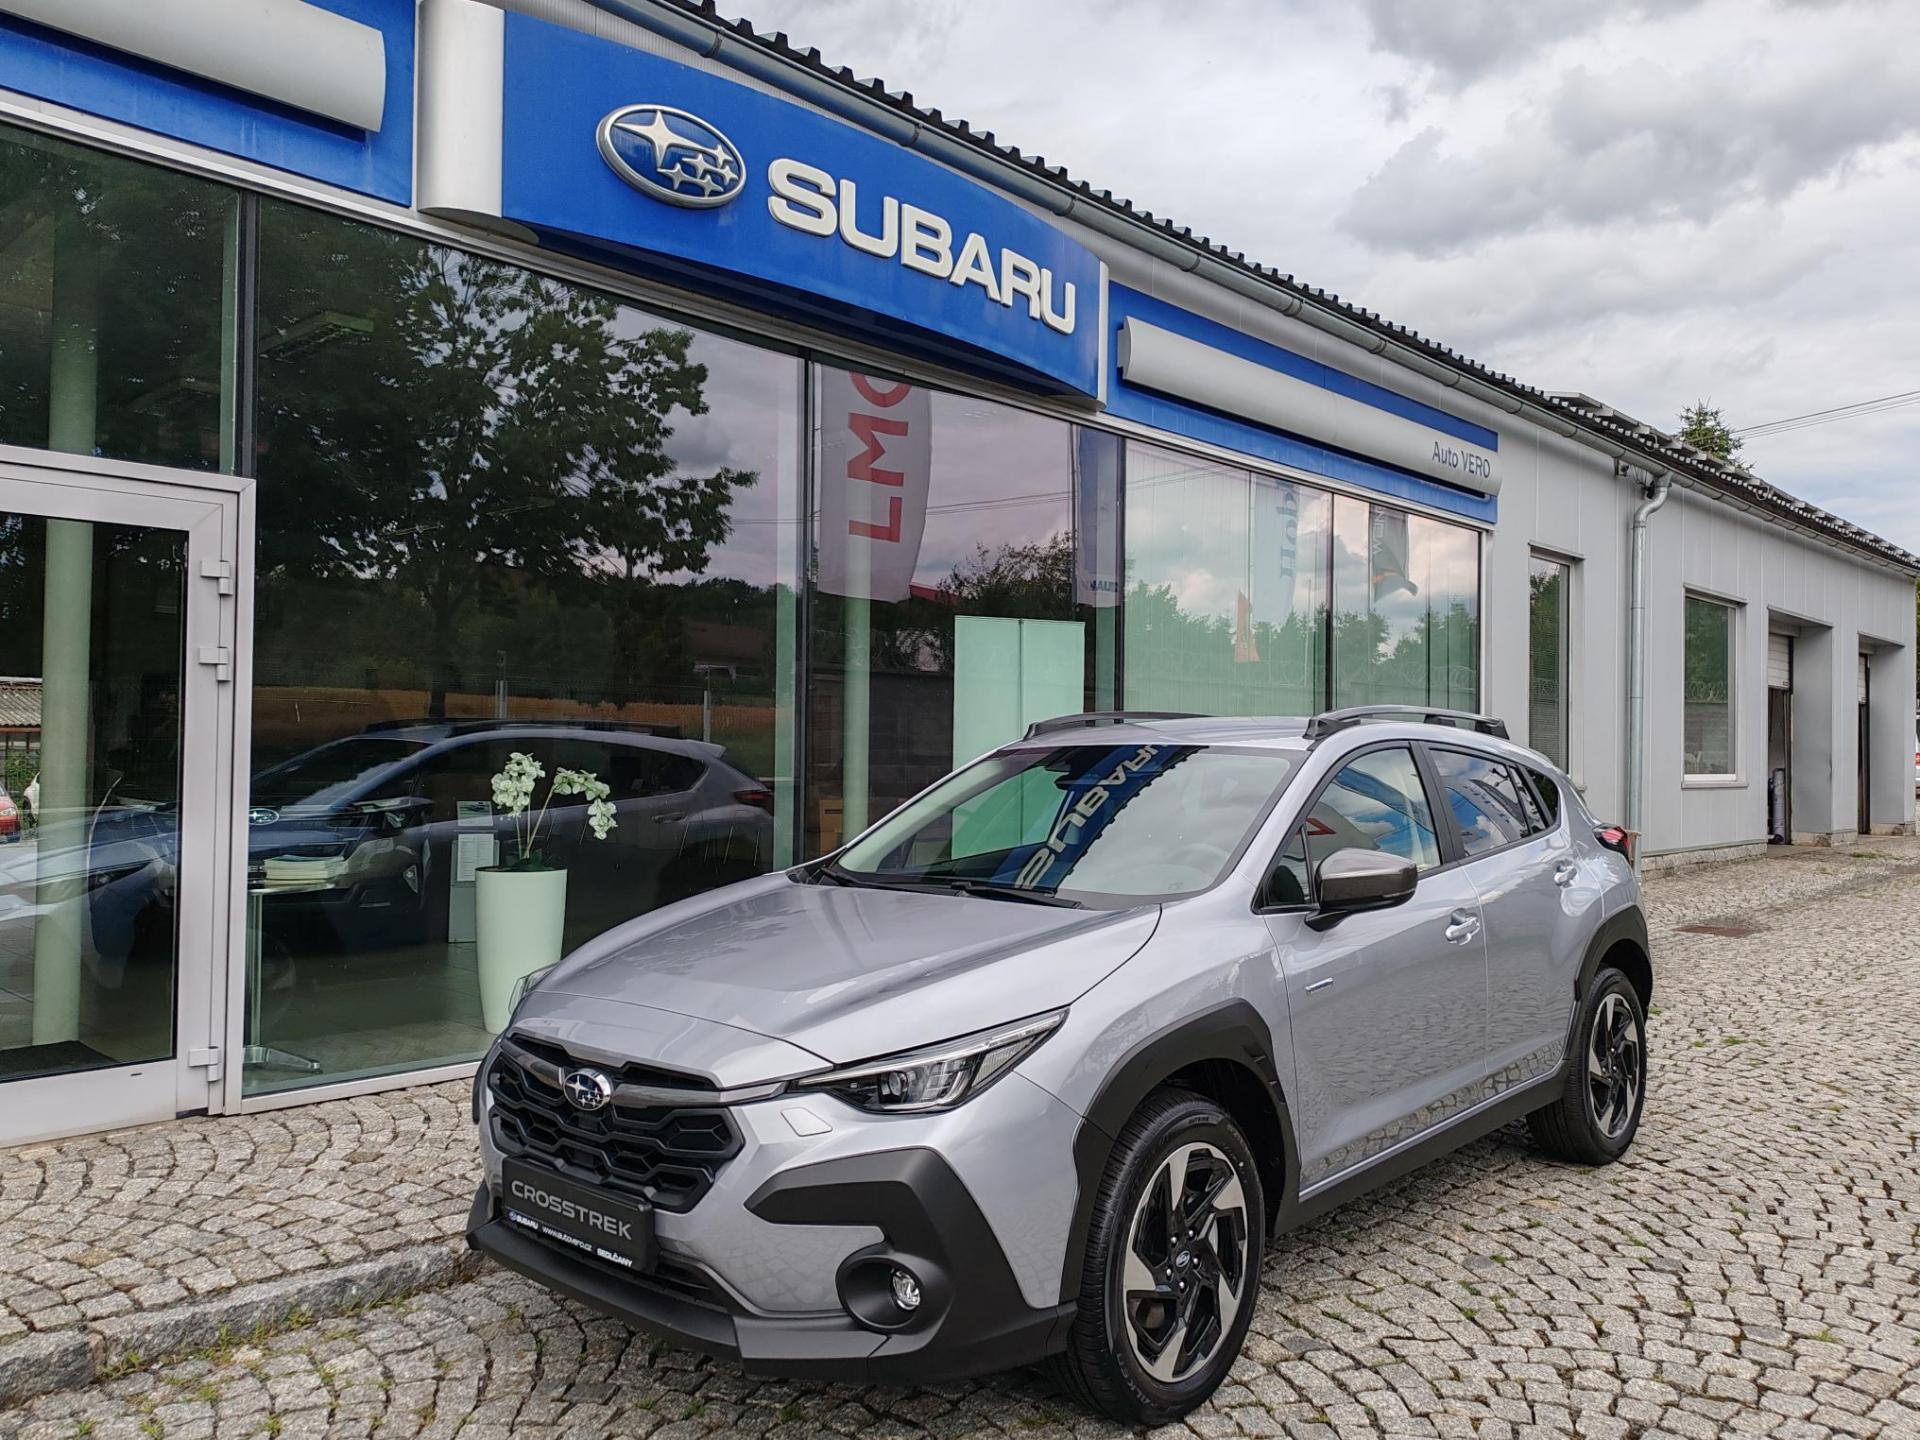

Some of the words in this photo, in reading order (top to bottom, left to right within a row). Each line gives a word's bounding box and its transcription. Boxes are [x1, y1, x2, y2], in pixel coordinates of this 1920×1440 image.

[768, 158, 1075, 334] SUBARU
[1432, 441, 1459, 468] Auto
[1461, 451, 1490, 478] VERO
[511, 1180, 632, 1240] CROSSTREK
[516, 1215, 538, 1230] SUBARU
